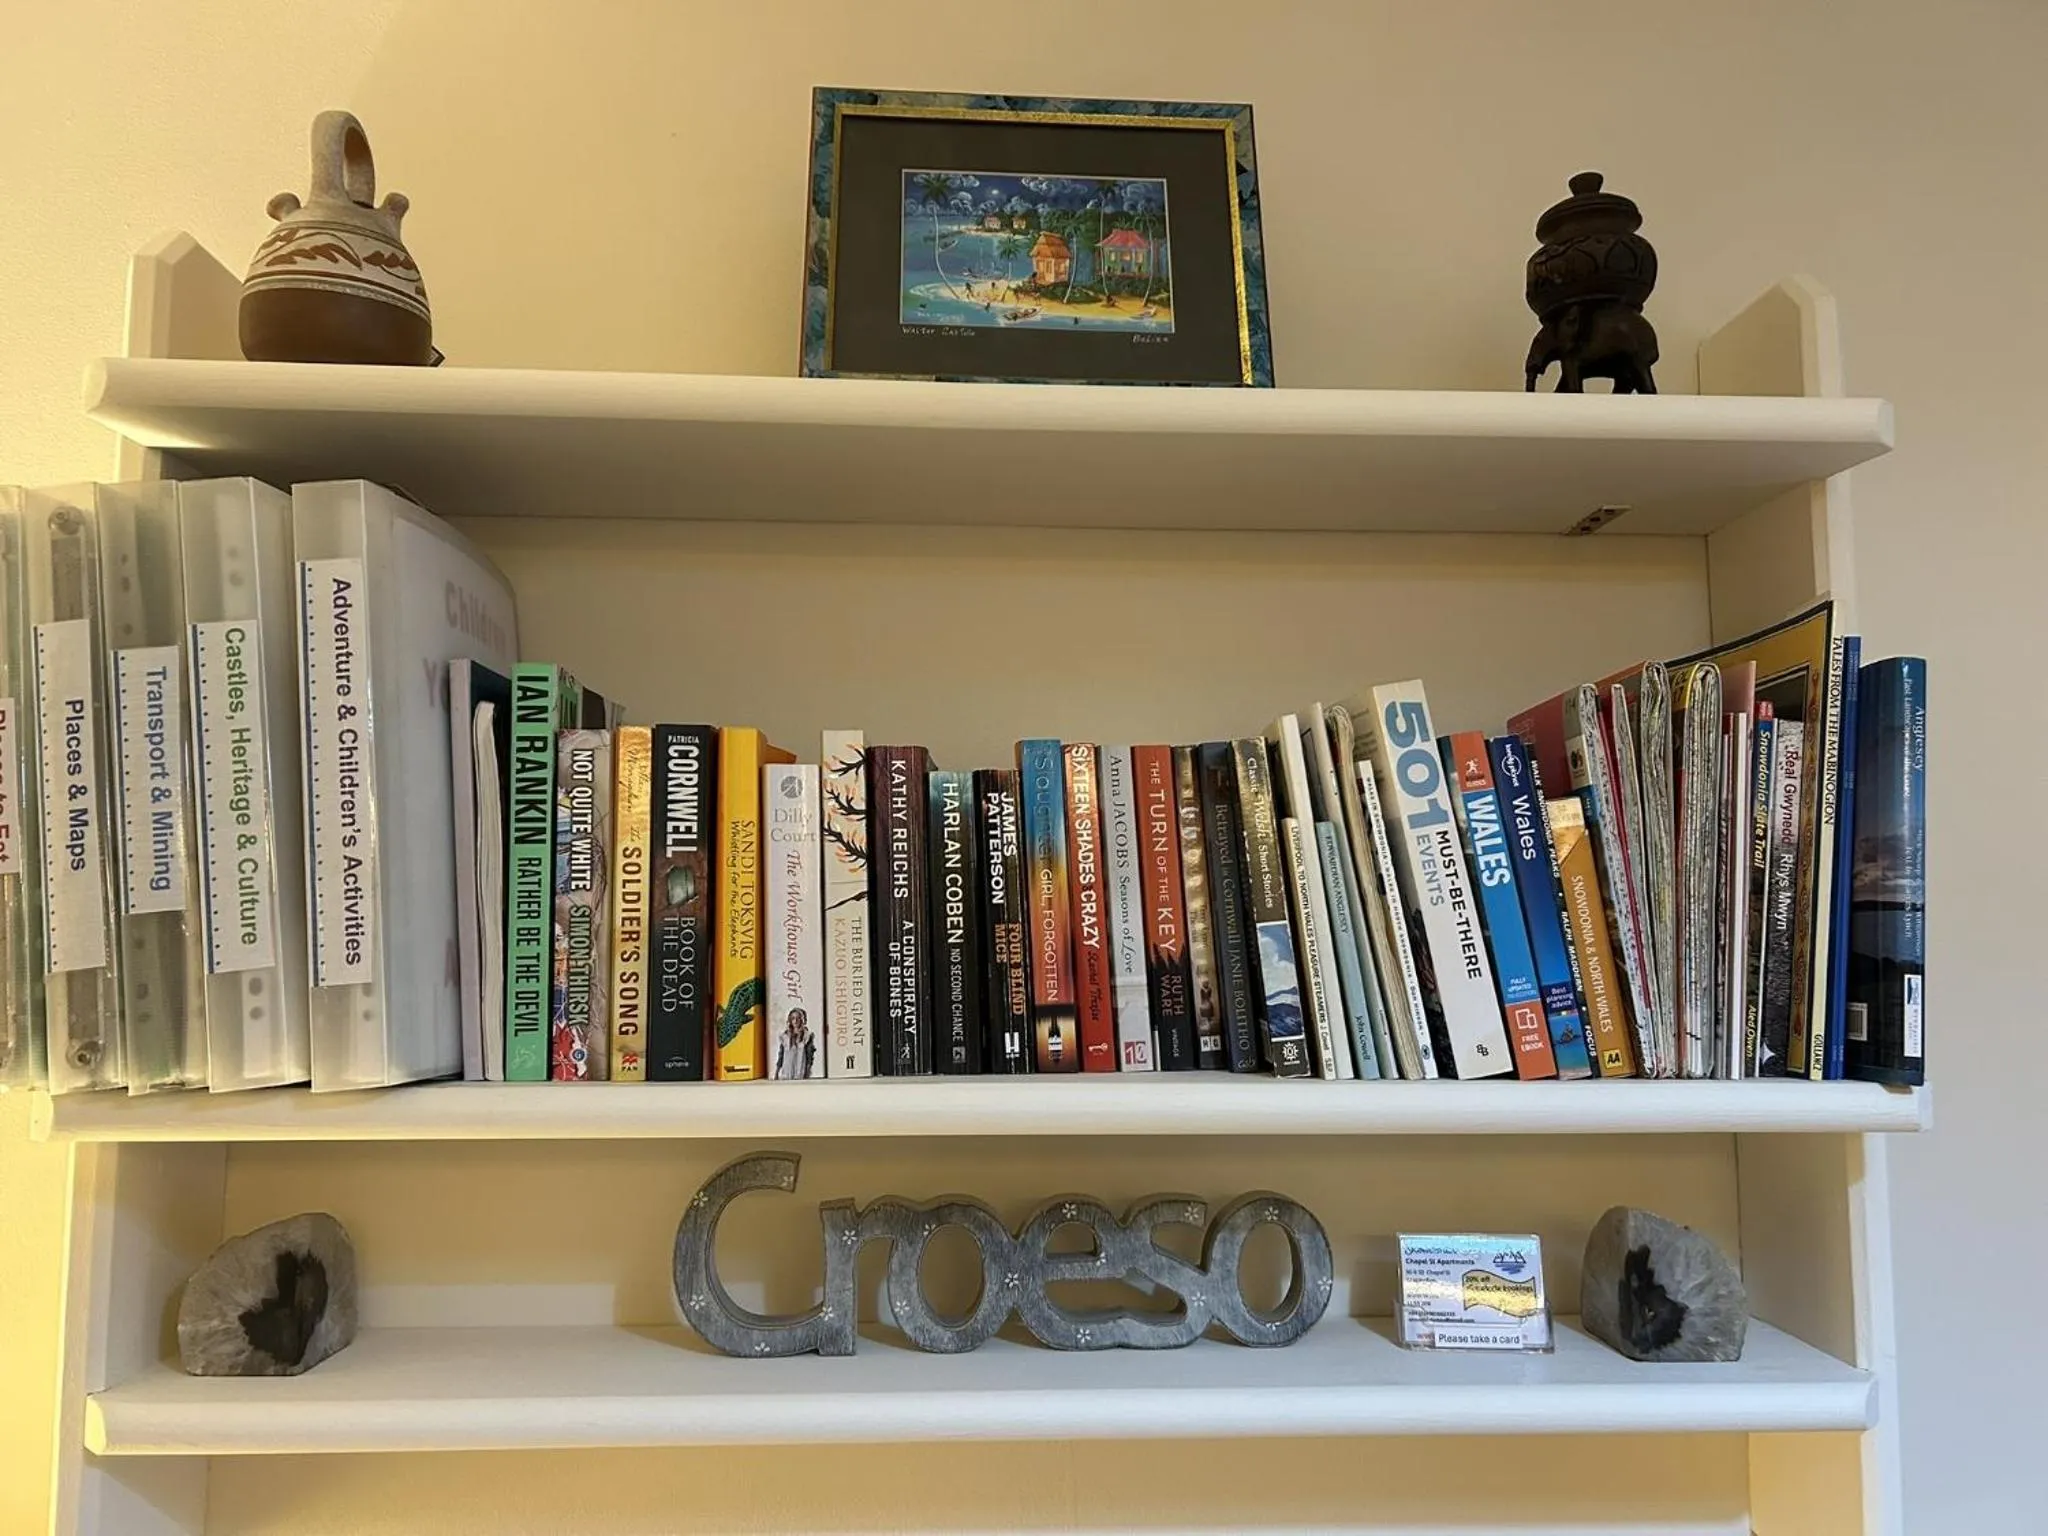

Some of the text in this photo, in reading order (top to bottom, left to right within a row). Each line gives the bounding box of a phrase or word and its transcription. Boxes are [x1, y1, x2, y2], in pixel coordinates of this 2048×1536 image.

[65, 699, 89, 871] Places & Maps
[144, 666, 174, 892] Transport & Mining
[224, 628, 263, 946] Castles, Heritage & Culture
[332, 578, 366, 966] Adventure & Children's Activities
[668, 735, 699, 743] PATRICIA
[1247, 757, 1260, 792] Classic
[1383, 700, 1450, 829] 501
[1758, 730, 1770, 801] Snowdonia
[1913, 706, 1924, 771] Anglesey
[665, 744, 699, 858] CORNWELL
[771, 828, 817, 842] Court
[775, 808, 812, 827] Dilly
[890, 760, 908, 899] KATHY REICHS
[987, 792, 1004, 904] PATTERSON
[1001, 792, 1018, 857] JAMES
[1366, 777, 1374, 800] WALKS
[1371, 802, 1377, 811] IN
[1374, 814, 1388, 860] SNOWDONIA
[1384, 867, 1394, 893] WALKS
[1391, 895, 1397, 904] IN
[1465, 794, 1511, 887] WALES
[1512, 795, 1537, 860] Wales
[1755, 801, 1766, 837] Slate
[1775, 751, 1798, 930] Real Gwynedd Rhys Mwyn
[514, 675, 549, 1038] IAN RANKIN RATHER BE THE DEVIL
[569, 750, 593, 1026] NOT QUITE WHITE SIMON THIRSK
[727, 821, 740, 958] Whistling for the Elephants
[739, 820, 754, 960] SANDI TOKSVIG
[1039, 869, 1053, 907] GIRL,
[1076, 819, 1096, 884] SHADES
[1109, 755, 1135, 974] Anna JACOBS Seasons of Love
[1148, 761, 1177, 953] THE TURN OF THE KEY
[1258, 844, 1270, 872] Short
[1261, 873, 1275, 908] Stories
[1415, 833, 1445, 907] EVENTS
[1753, 839, 1767, 867] Trail
[1812, 635, 1844, 1072] TALES FROM THE MABINOGION GOLLANCZ
[619, 847, 642, 1036] SOLDIER'S SONG
[781, 850, 803, 1002] The Workhouse Girl
[942, 782, 964, 1042] HARLAN COBEN NO SECOND CHANCE
[994, 924, 1007, 963] MICE
[1080, 890, 1100, 950] CRAZY
[1214, 804, 1250, 1050] Betrayed Cornwall JANIE BOLITHO
[1291, 825, 1327, 1024] LIVERPOOL TO NORTH WALES PLEASURE STEAMERS
[1325, 835, 1370, 1060] EDWARDIAN ANGLESEY John Cowell
[1435, 829, 1483, 980] MUST-BE-THERE
[1531, 759, 1597, 1057] WALK SNOWDONIA PEAKS RALPH MADDERN FOCUS
[661, 915, 678, 1013] THE DEAD
[678, 916, 696, 1011] BOOK OF
[834, 917, 848, 1047] KAZUO ISHIGURO
[851, 917, 865, 1046] THE BURIED GIANT
[888, 942, 902, 1018] OF BONES
[902, 920, 916, 1035] A CONSPIRACY
[1008, 923, 1024, 1015] FOUR BLIND
[1041, 909, 1058, 1002] FORGOTTEN
[1160, 974, 1173, 1017] WARE
[1171, 974, 1184, 1016] RUTH
[1570, 875, 1613, 1033] SNOWDONIA & NORTH WALES
[1171, 1028, 1179, 1058] VINTAGE
[1607, 1050, 1620, 1066] AA
[1745, 1028, 1756, 1058] Owen
[1746, 1004, 1757, 1028] Aled
[1438, 1332, 1468, 1345] Please
[1470, 1333, 1490, 1344] take
[1500, 1334, 1520, 1344] card
